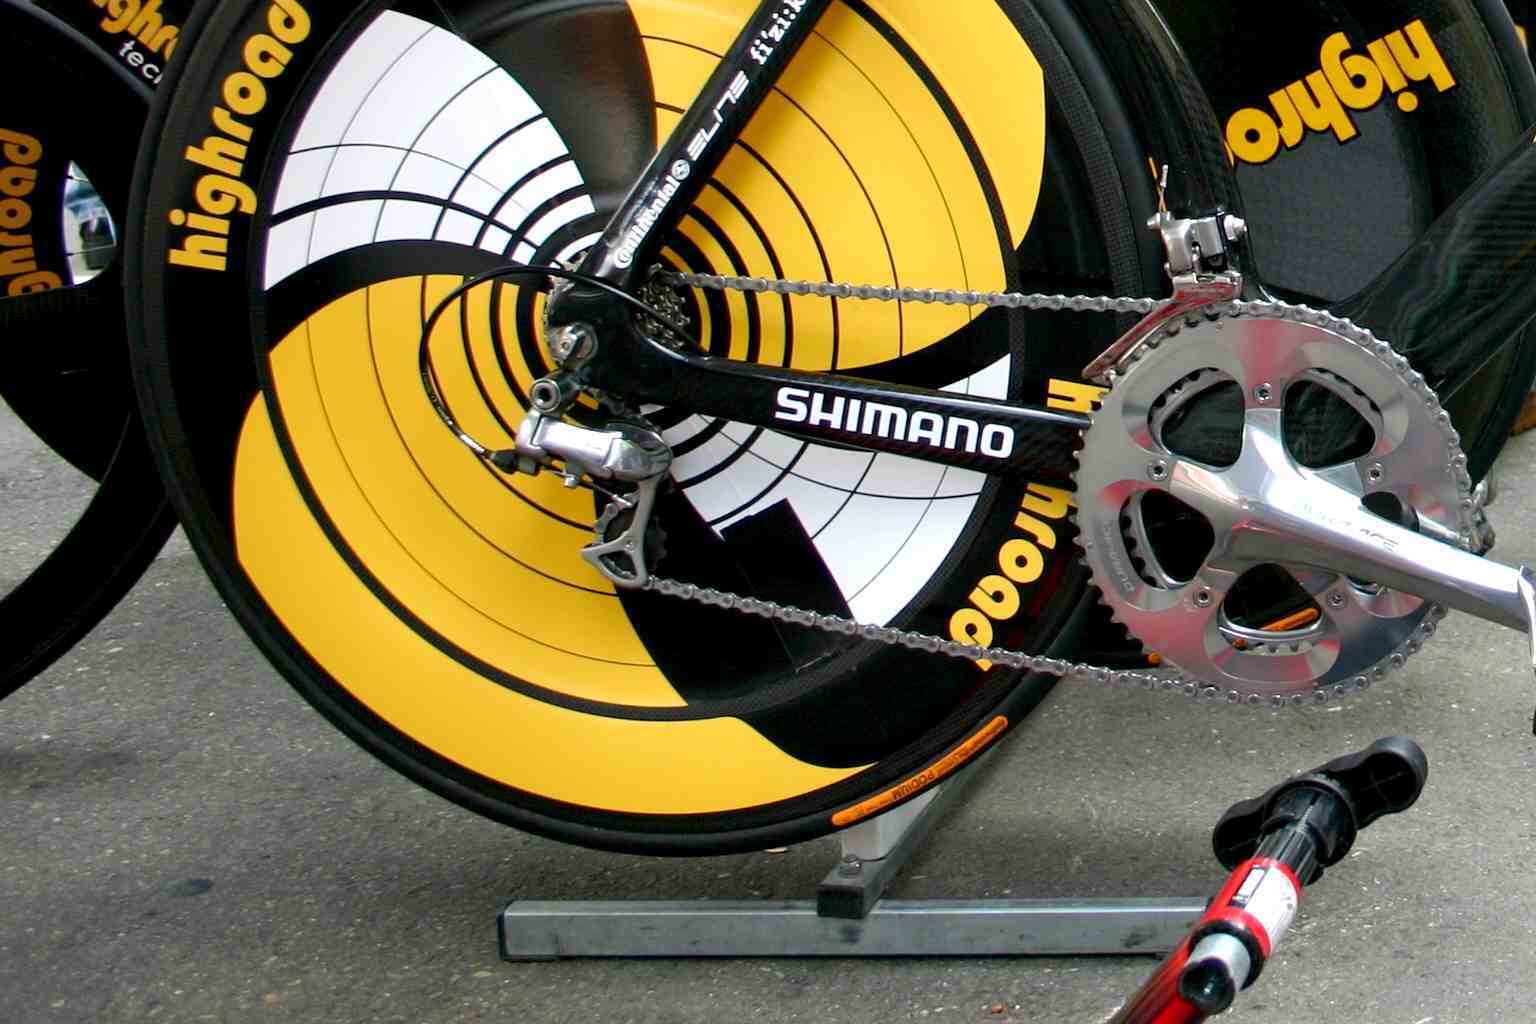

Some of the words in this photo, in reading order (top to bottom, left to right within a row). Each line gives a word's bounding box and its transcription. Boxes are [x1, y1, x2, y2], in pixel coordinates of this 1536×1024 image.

[1224, 18, 1457, 165] highro
[615, 175, 681, 269] Continental
[774, 386, 1015, 459] SHIMANO
